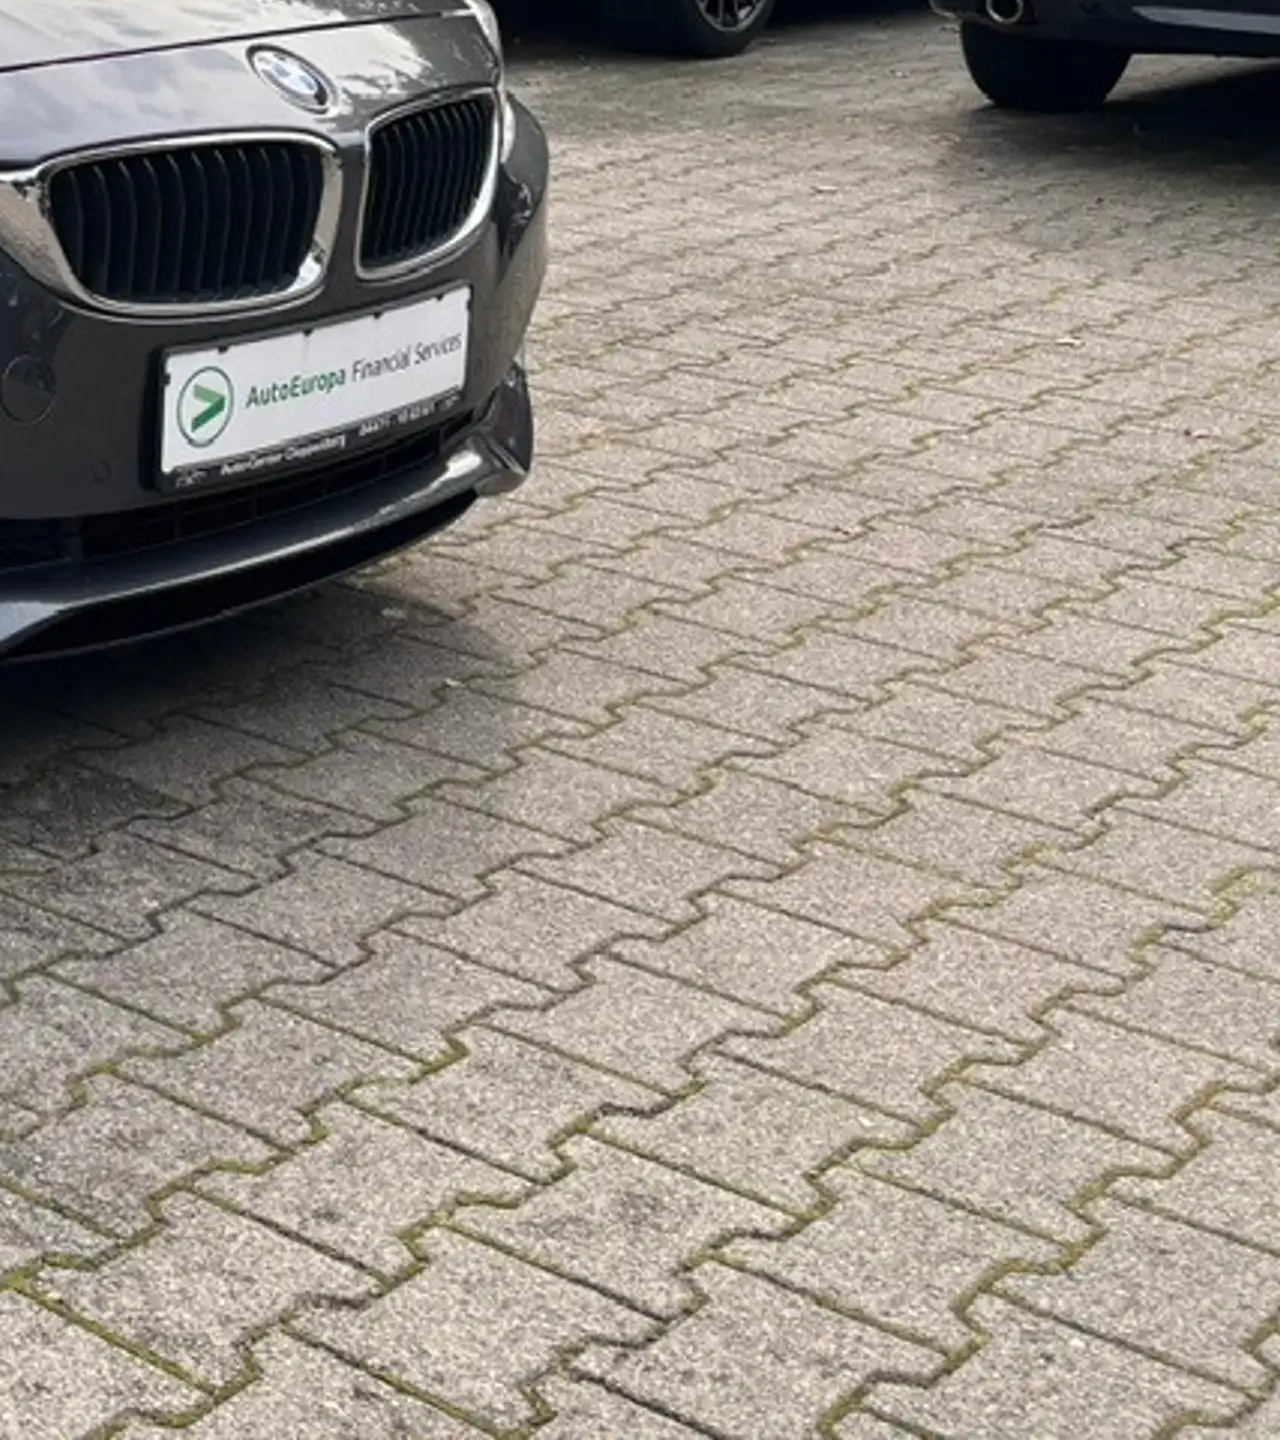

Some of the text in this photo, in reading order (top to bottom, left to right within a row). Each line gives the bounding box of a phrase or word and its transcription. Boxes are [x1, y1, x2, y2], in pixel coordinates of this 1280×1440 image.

[245, 332, 462, 408] AutoEuropa Financial Services
